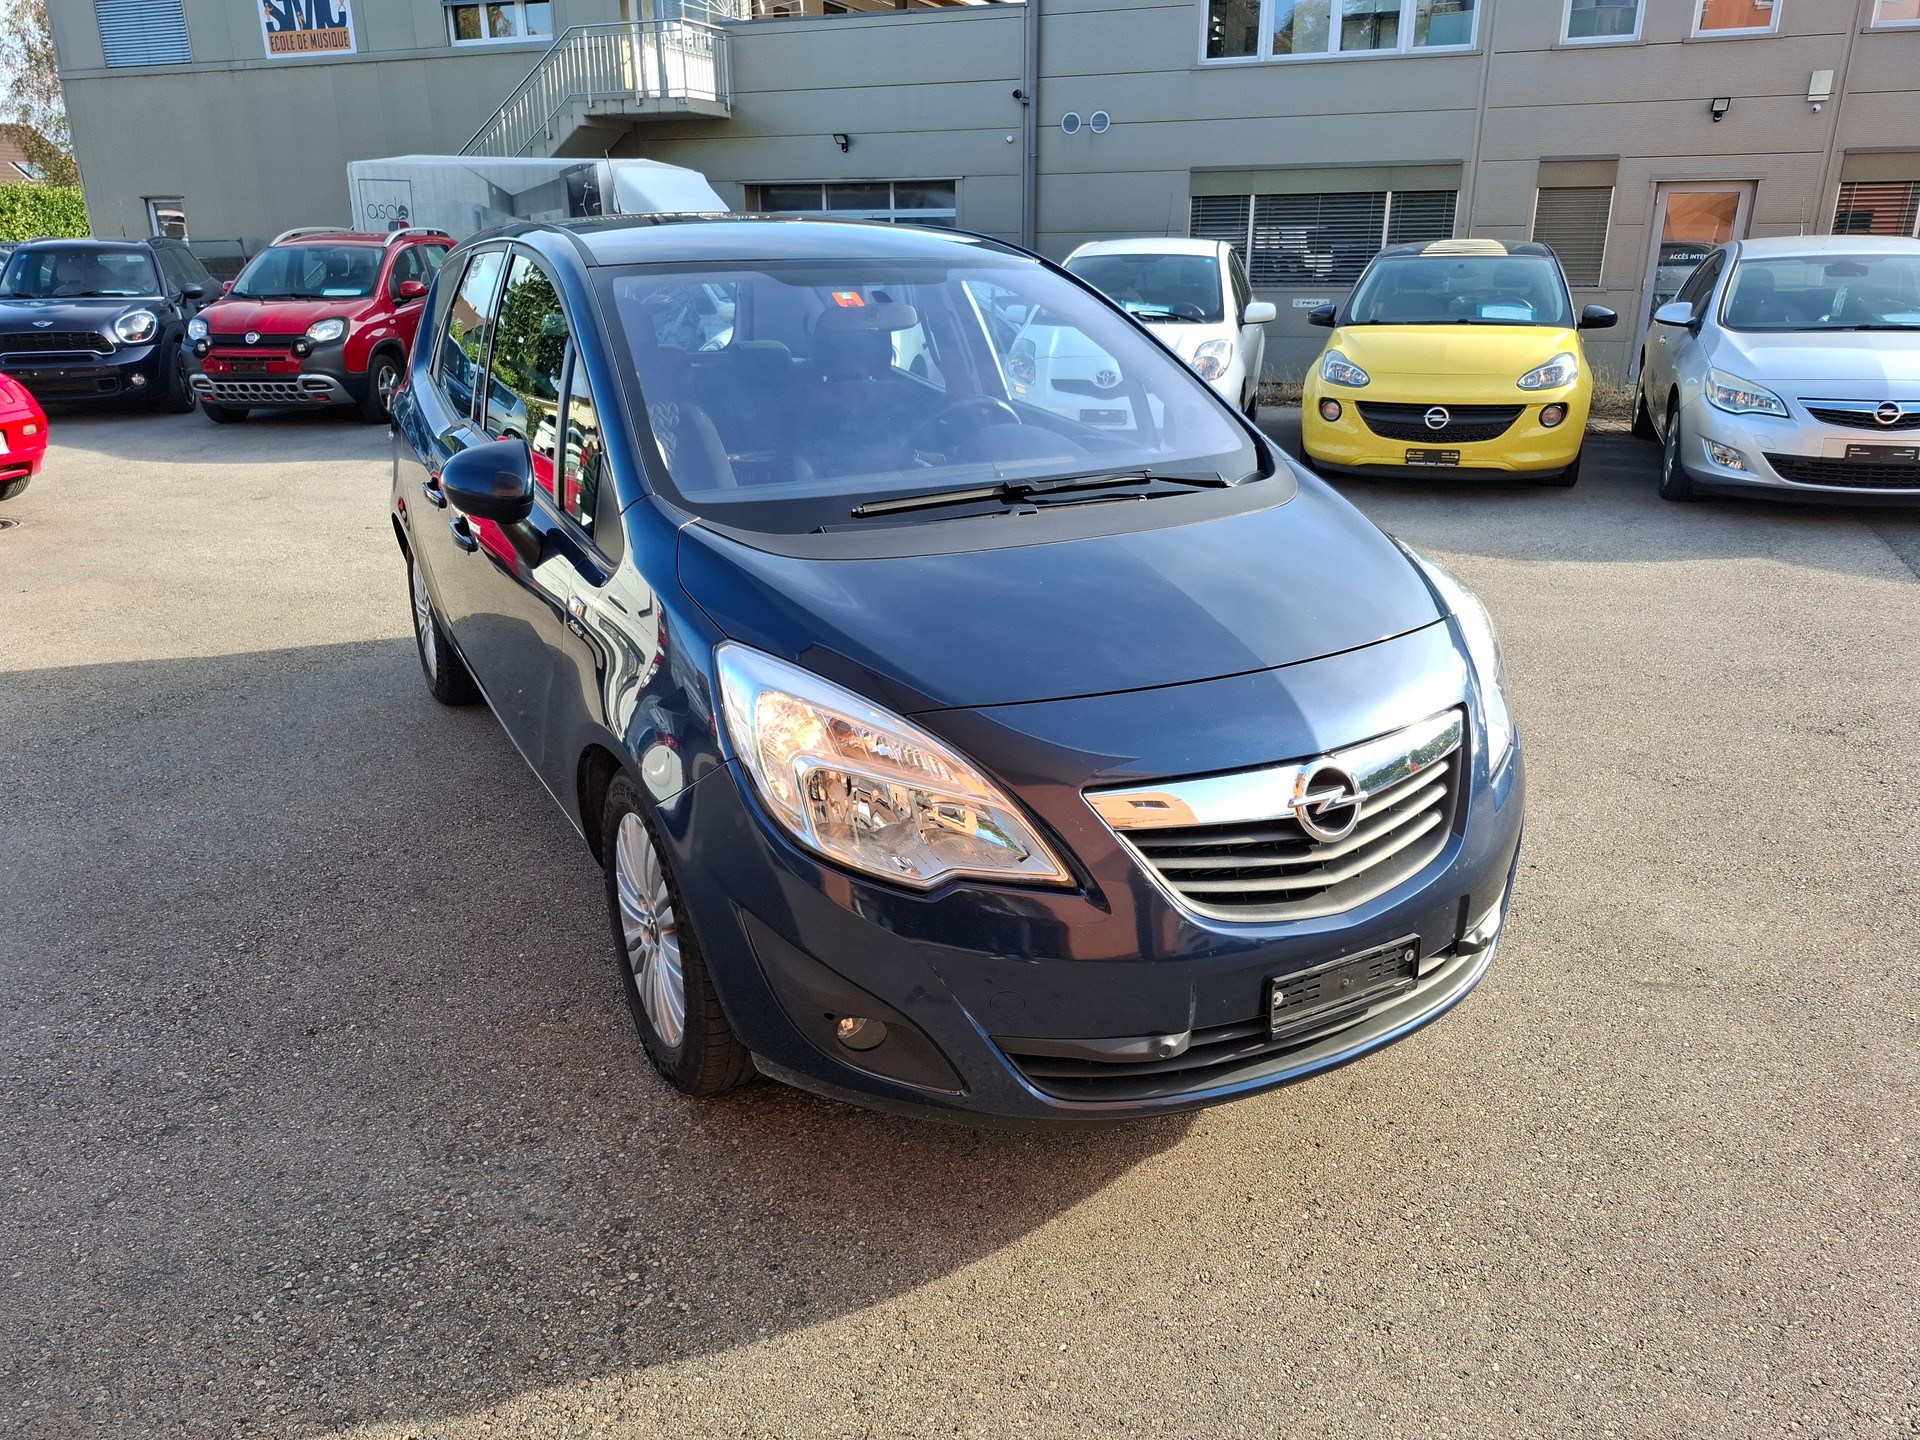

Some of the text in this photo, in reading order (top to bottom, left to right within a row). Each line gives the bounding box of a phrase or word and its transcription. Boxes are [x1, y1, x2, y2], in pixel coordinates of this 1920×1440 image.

[270, 30, 349, 52] ECOLE DE MUSIQUE
[1669, 252, 1689, 260] ACCÈS
